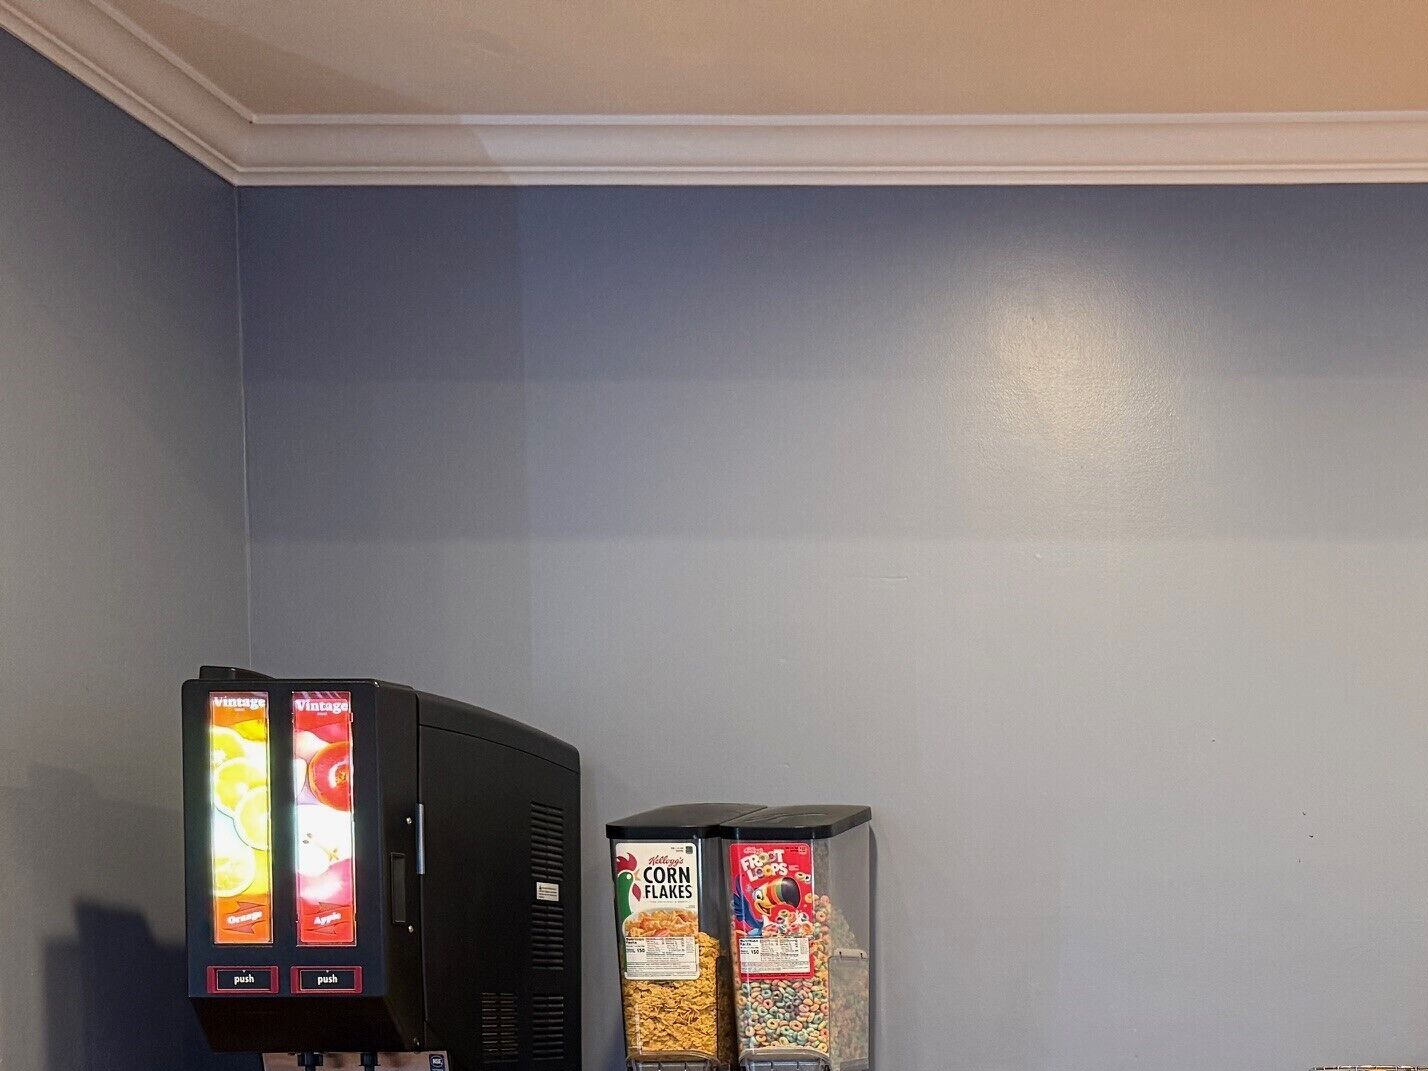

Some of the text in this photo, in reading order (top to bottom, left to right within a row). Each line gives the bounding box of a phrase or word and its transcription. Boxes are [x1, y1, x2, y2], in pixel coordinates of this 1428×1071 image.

[214, 696, 266, 710] Vintage
[295, 699, 349, 714] Vintage
[648, 855, 684, 867] Kellogg's
[741, 849, 785, 872] FROOT
[643, 867, 691, 884] CORN
[746, 862, 789, 882] LOOPS
[645, 885, 693, 899] FLAKES
[226, 911, 263, 925] Orange
[313, 912, 342, 926] Apple
[234, 974, 255, 985] push
[317, 974, 338, 985] push
